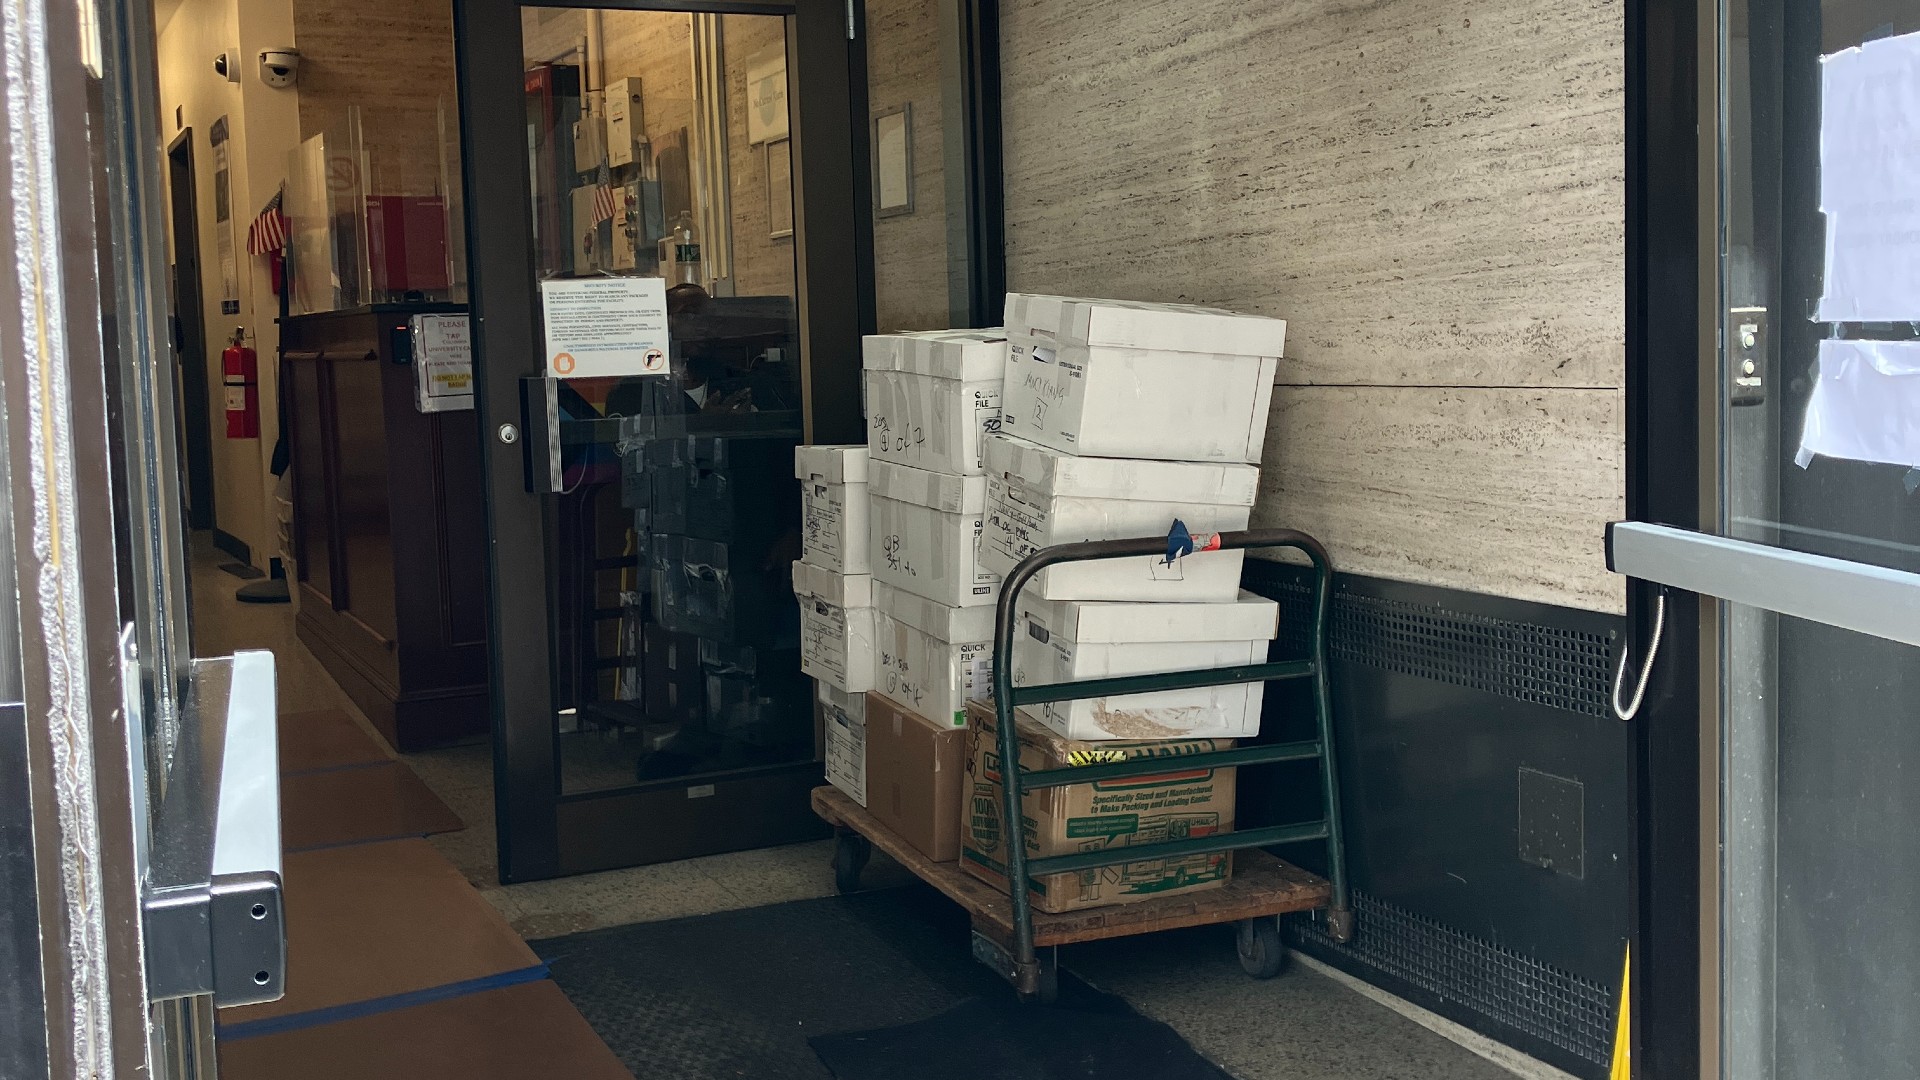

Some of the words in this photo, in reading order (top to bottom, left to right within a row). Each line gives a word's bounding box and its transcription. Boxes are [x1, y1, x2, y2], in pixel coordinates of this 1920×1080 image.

[975, 399, 989, 408] FILE
[960, 643, 986, 653] QUICK
[1092, 793, 1134, 805] Specifically
[1135, 791, 1154, 801] Sized
[1155, 790, 1168, 799] and
[1168, 784, 1213, 797] Manufactured
[1090, 806, 1098, 814] to
[1099, 804, 1120, 813] Make
[1120, 802, 1148, 812] Packing
[1149, 800, 1163, 808] and
[1163, 796, 1189, 808] Loading
